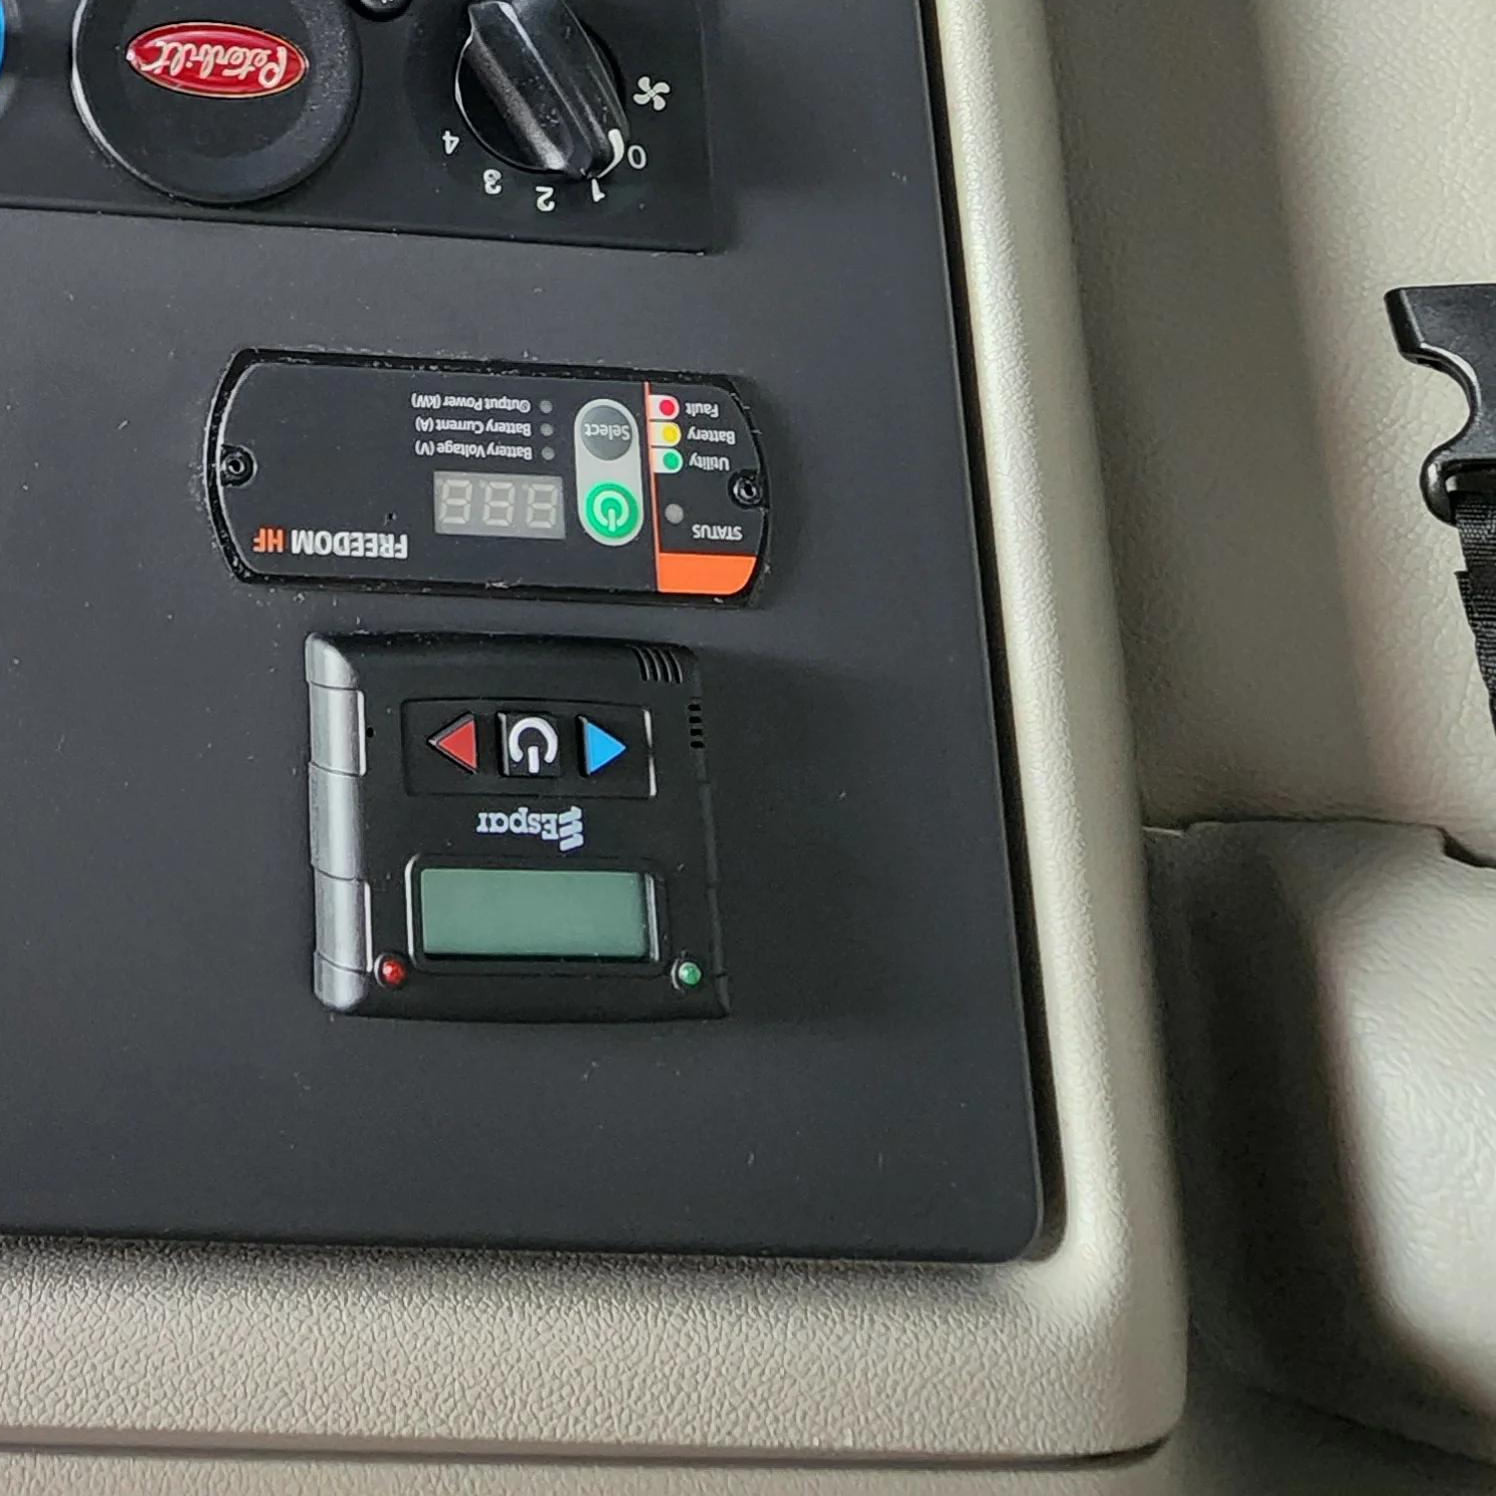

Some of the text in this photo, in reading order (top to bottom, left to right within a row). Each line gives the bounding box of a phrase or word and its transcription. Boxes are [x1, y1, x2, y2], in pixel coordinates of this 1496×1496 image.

[139, 39, 288, 89] Peterbilt
[442, 130, 460, 155] 4
[626, 144, 646, 170] 0
[482, 168, 502, 195] 3
[590, 178, 606, 203] 1
[534, 185, 556, 212] 2
[410, 393, 531, 414] Output Power (kW)
[684, 402, 720, 419] Fault
[414, 416, 532, 437] Battery Current (A)
[583, 422, 631, 441] Select
[687, 426, 736, 445] Battery
[414, 440, 533, 461] Battery Voltage (V)
[688, 451, 731, 471] Utility
[252, 527, 408, 559] FREEDOM HF
[691, 523, 743, 541] STATUS
[475, 806, 560, 841] Espar
